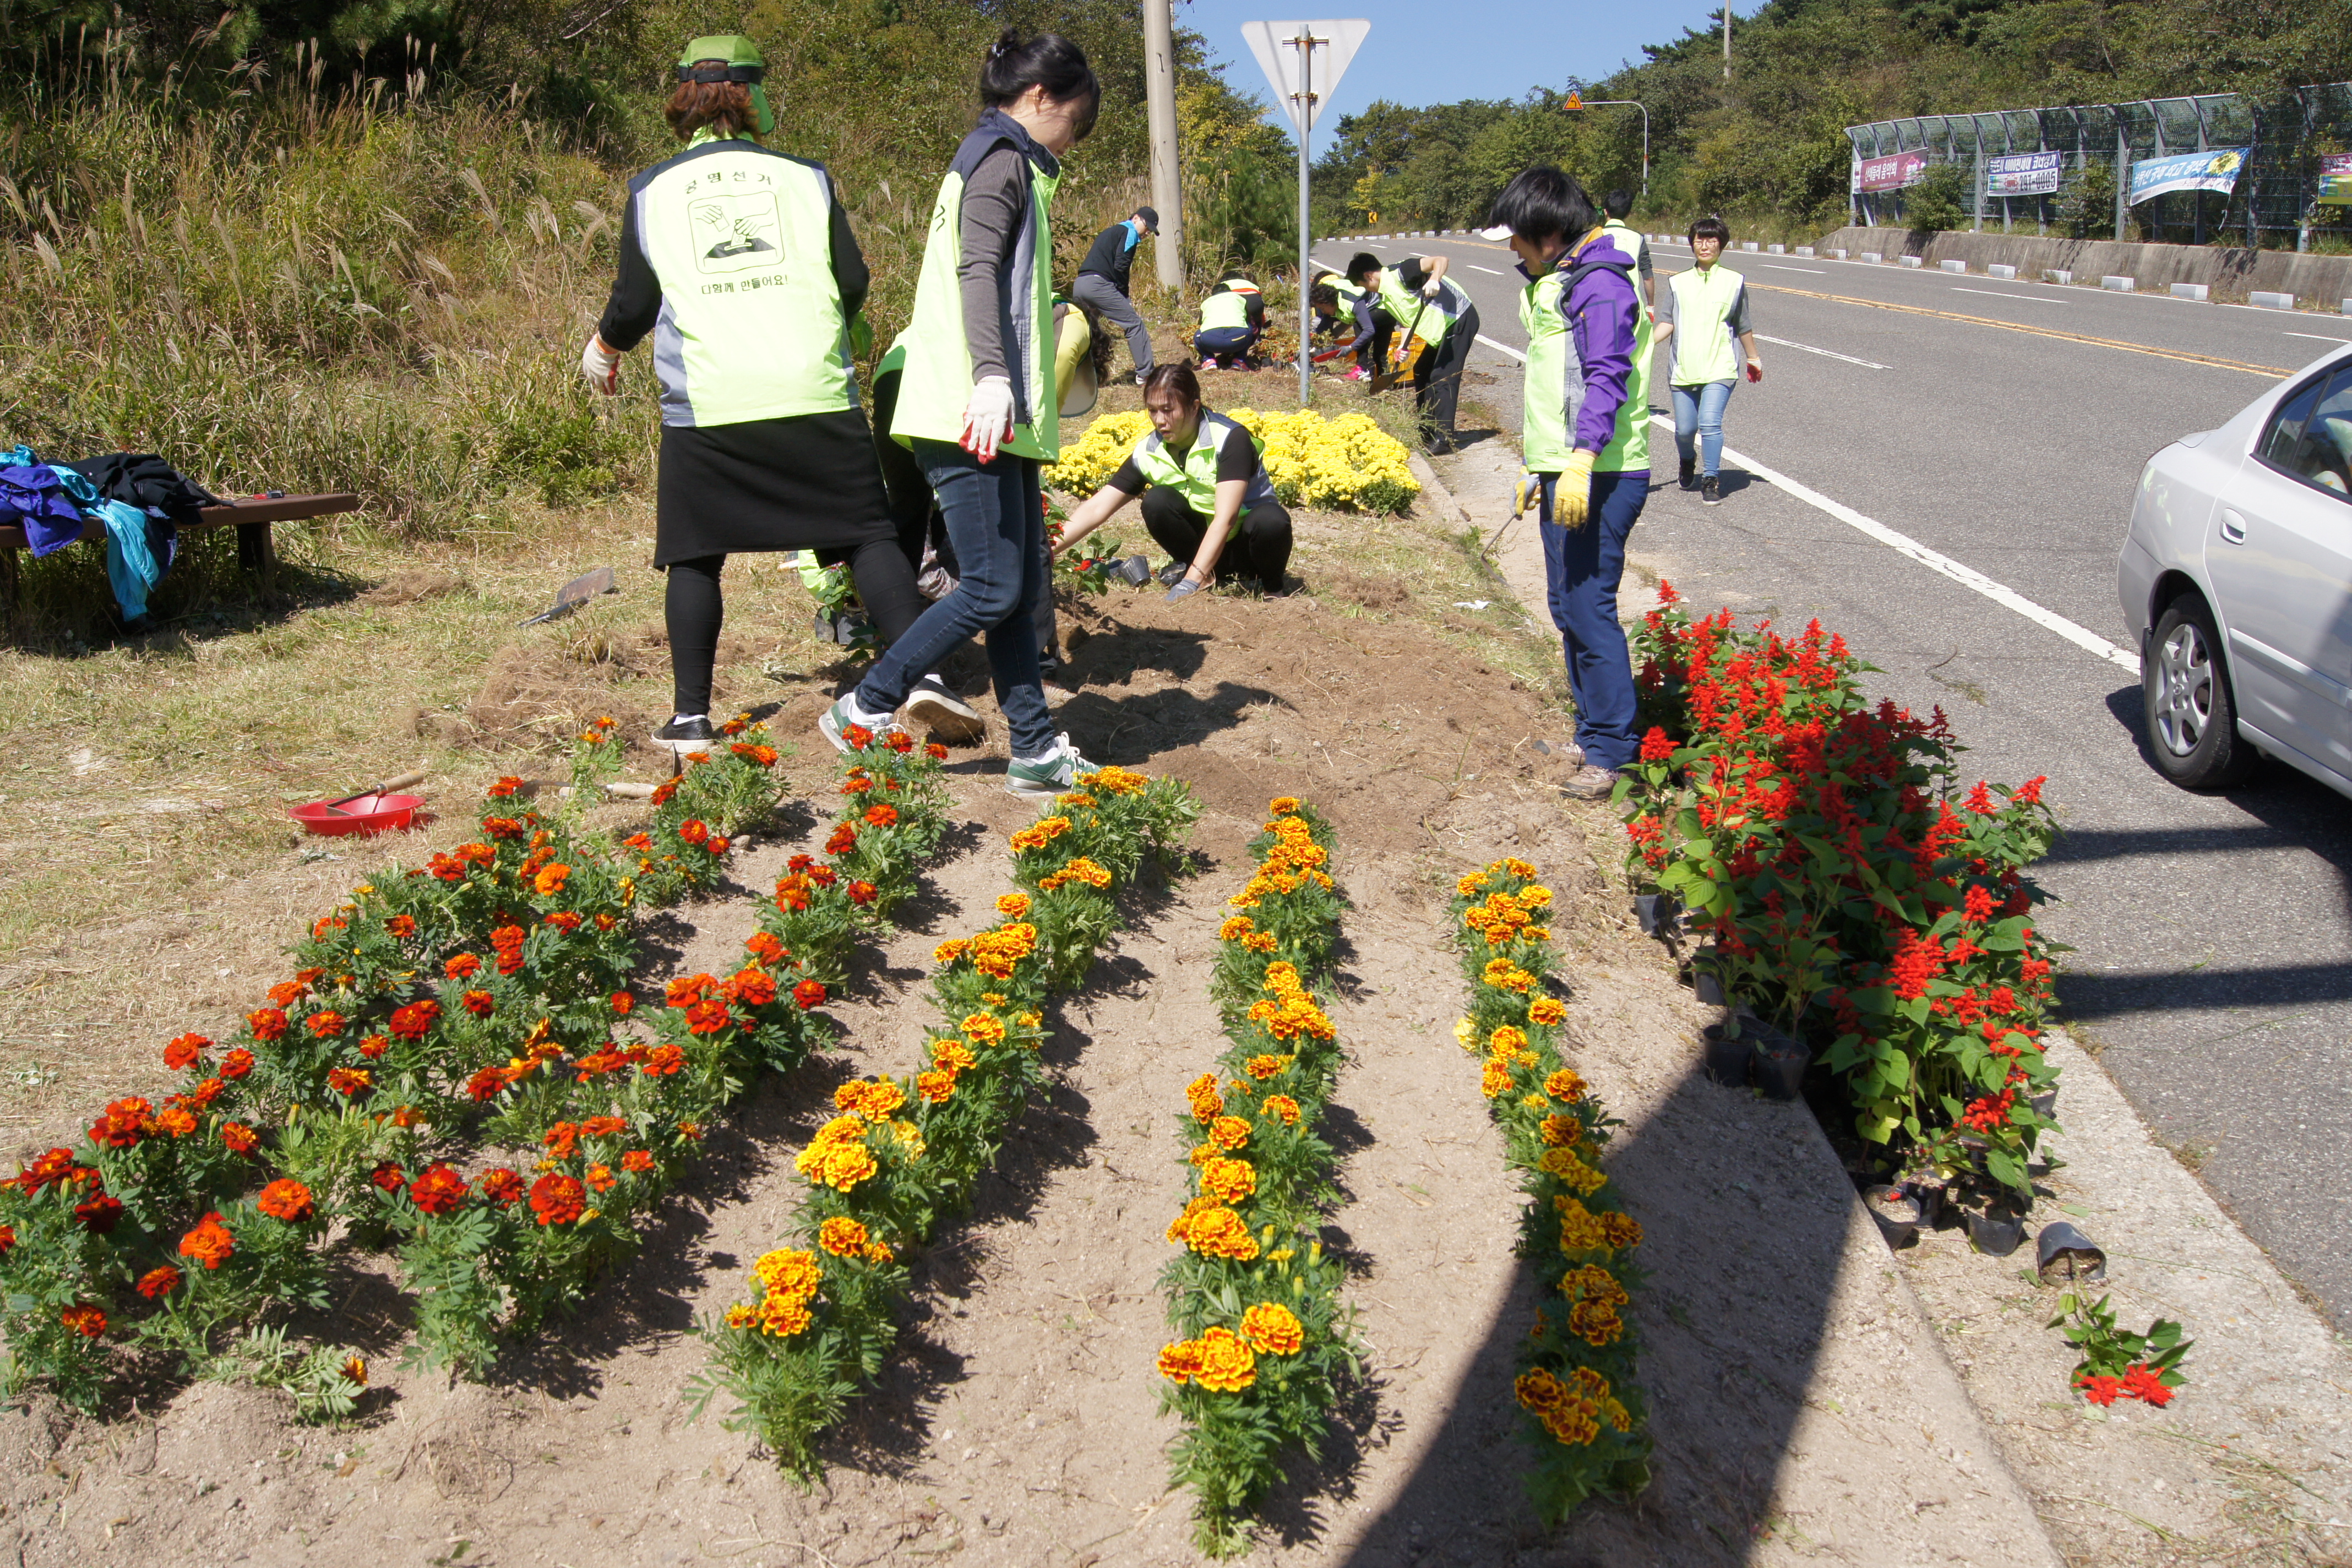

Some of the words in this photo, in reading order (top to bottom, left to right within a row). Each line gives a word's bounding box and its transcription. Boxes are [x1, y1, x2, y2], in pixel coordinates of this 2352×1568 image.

[1881, 158, 1898, 180] 음악회
[2032, 154, 2056, 169] 코너상가
[2019, 171, 2056, 191] 297-0005
[2134, 168, 2153, 188] 부동산
[2164, 162, 2187, 178] 최고
[701, 282, 734, 295] 다함께
[741, 275, 788, 291] 만들어요!
